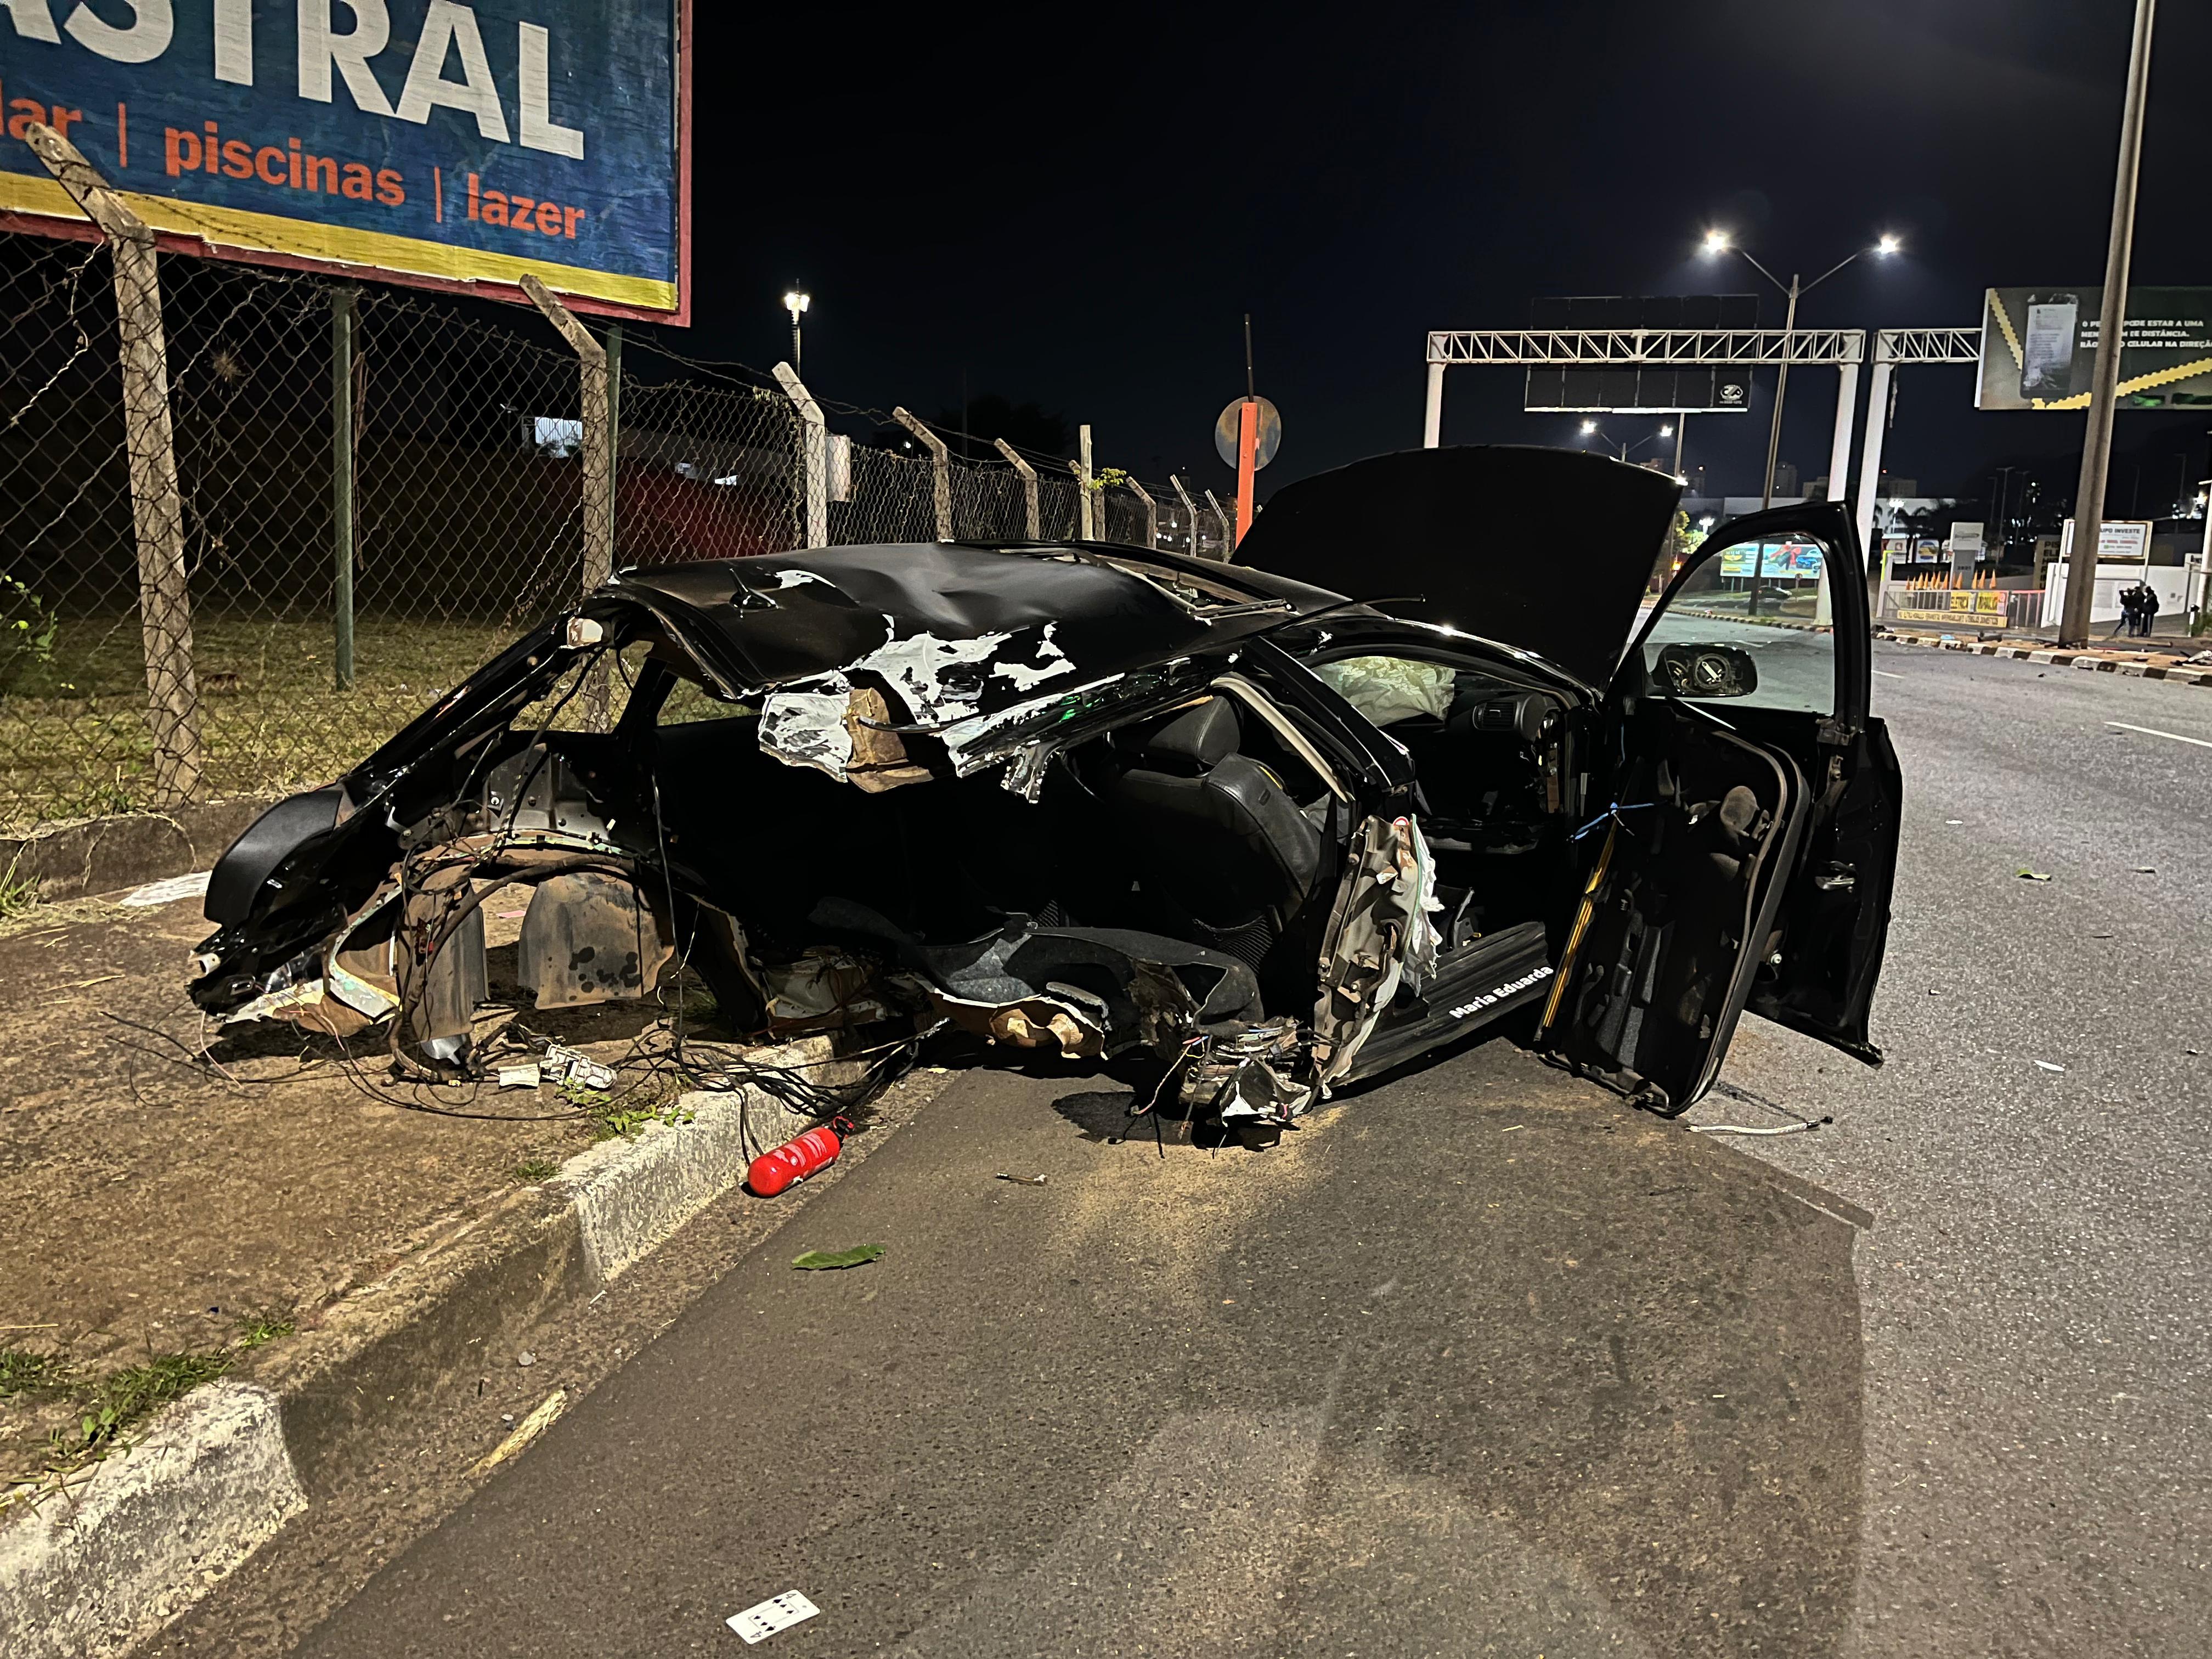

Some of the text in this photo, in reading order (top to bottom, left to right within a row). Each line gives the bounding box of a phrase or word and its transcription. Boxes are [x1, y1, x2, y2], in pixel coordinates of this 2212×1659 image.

[0, 0, 584, 160] TRAL
[165, 121, 405, 206] piscinas
[467, 172, 585, 239] lazer
[2180, 339, 2212, 349] DIREÇÃ
[1449, 967, 1554, 1018] Maria Eduarda
